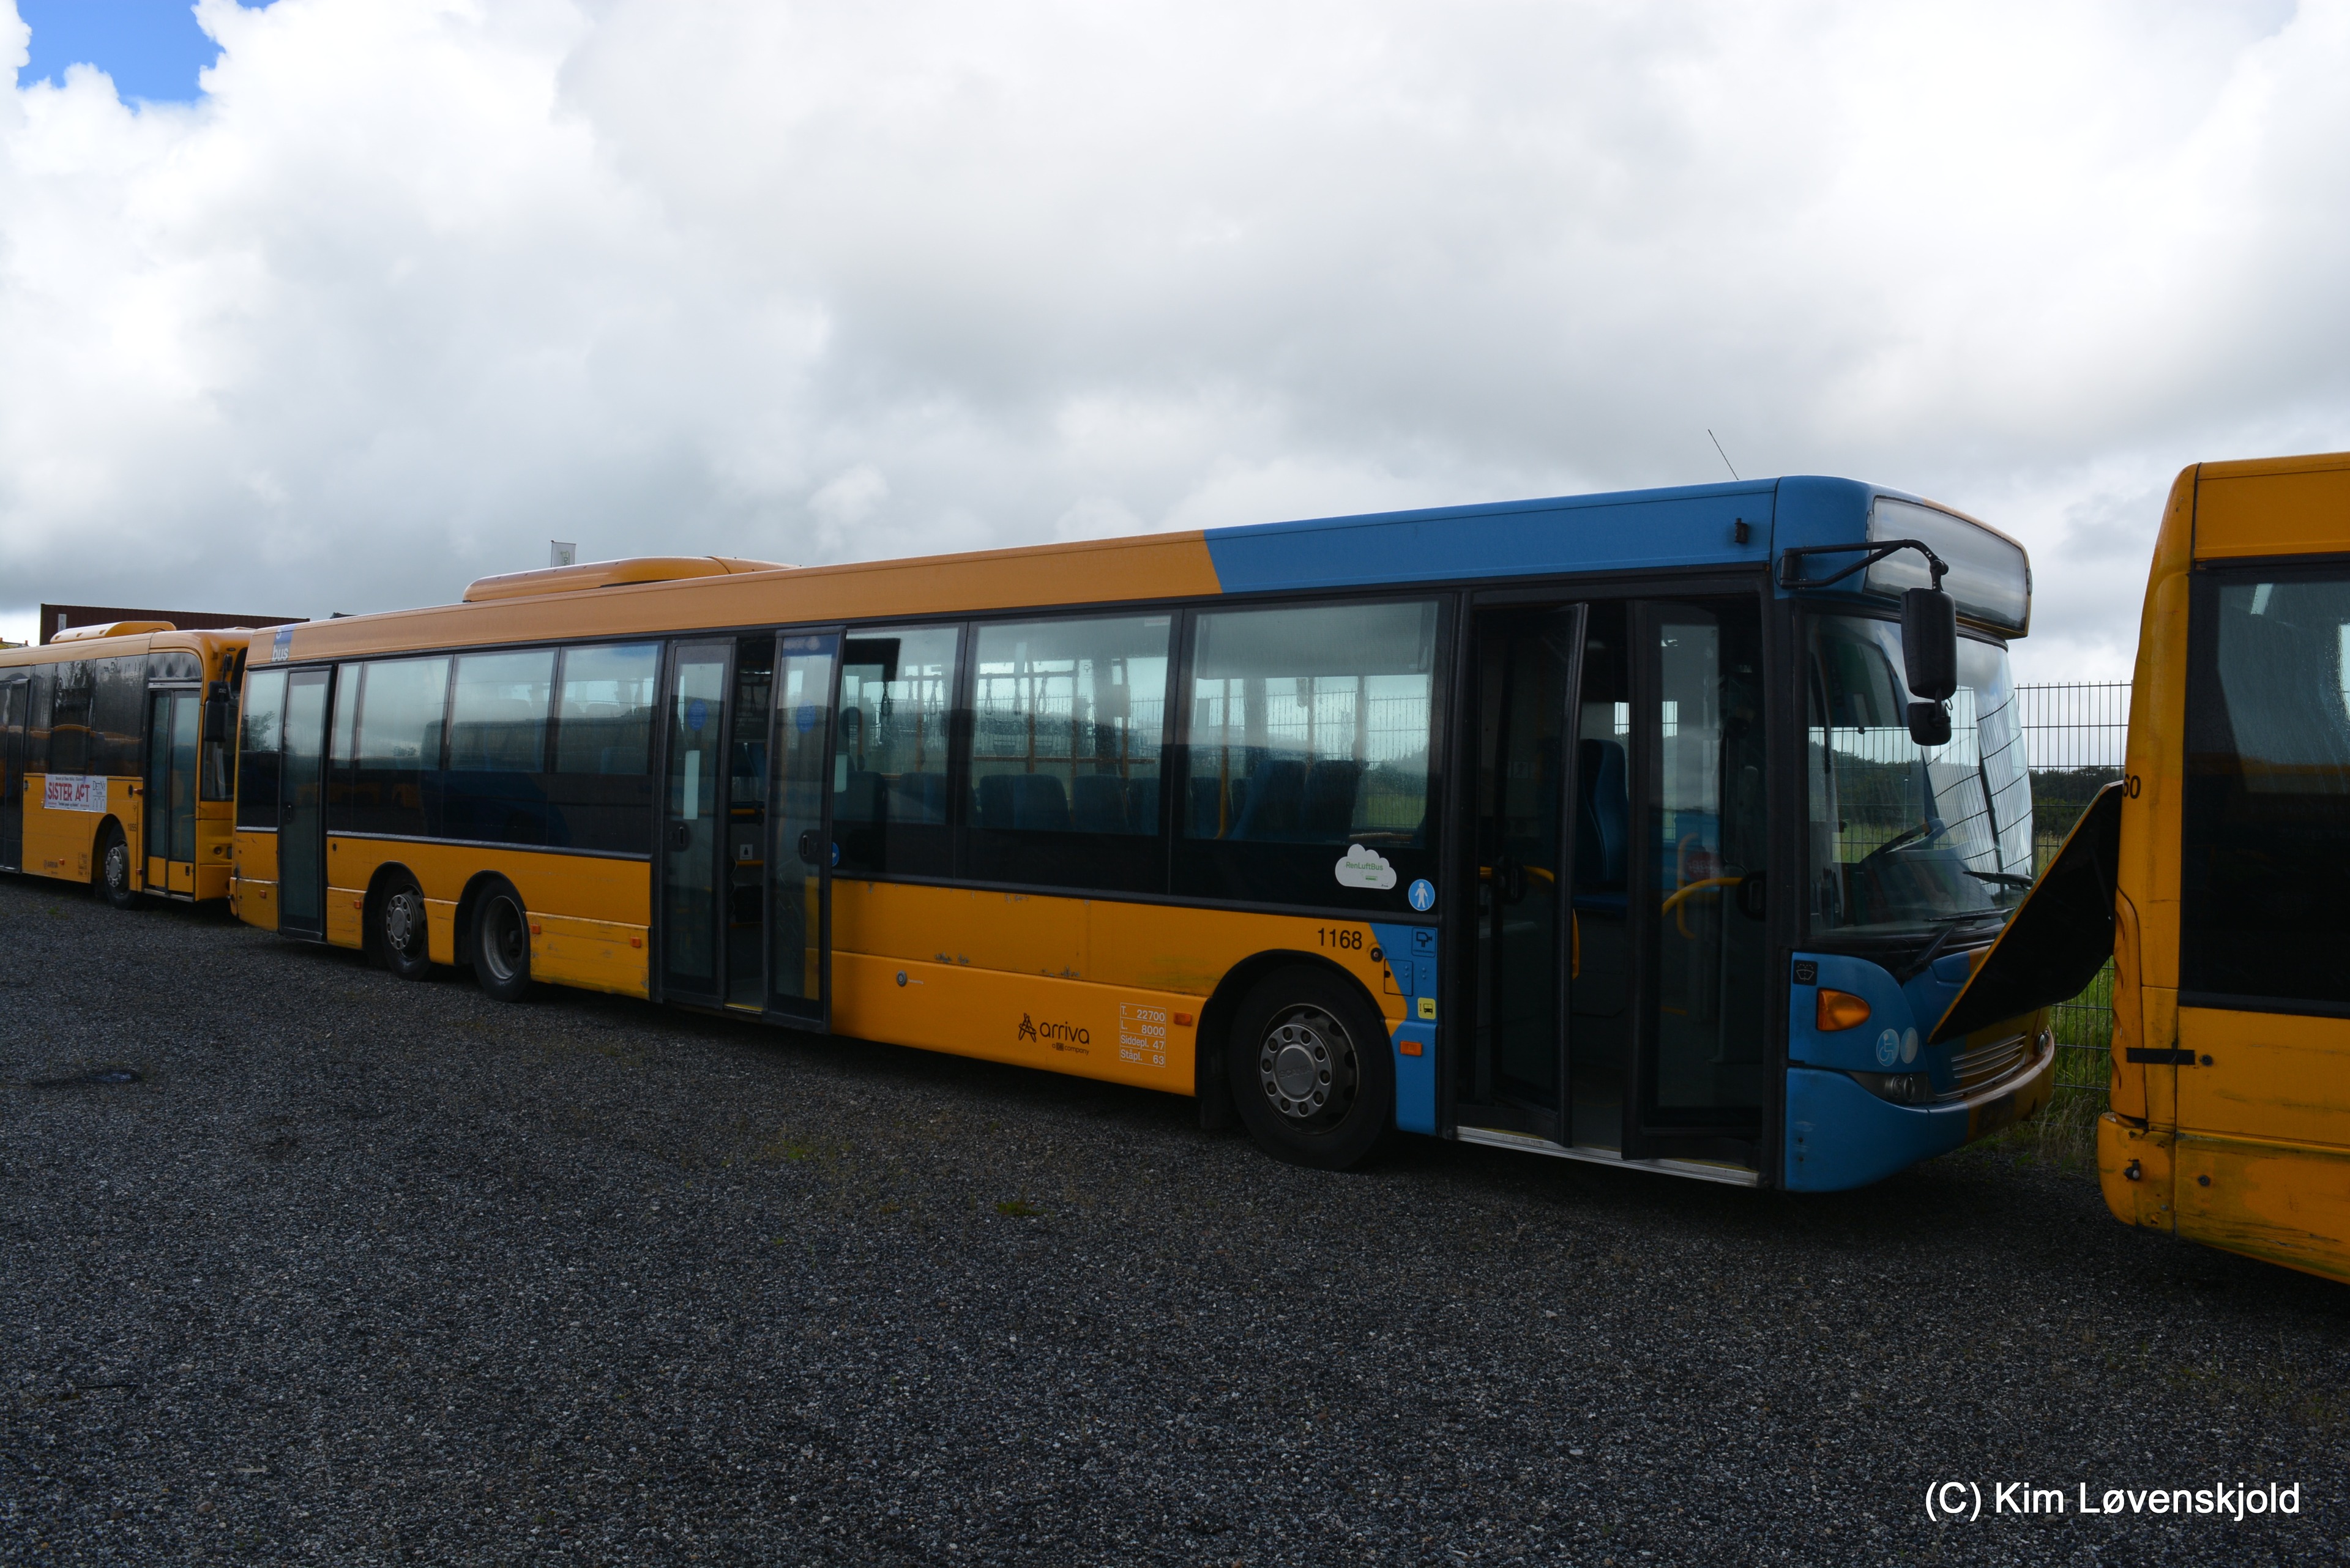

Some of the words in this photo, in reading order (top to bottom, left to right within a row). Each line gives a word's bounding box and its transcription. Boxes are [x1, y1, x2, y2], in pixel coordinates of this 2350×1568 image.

[272, 644, 289, 662] bus
[48, 782, 72, 801] SISTER
[75, 784, 90, 802] ACT
[1346, 861, 1383, 871] RenLuftBus
[1318, 927, 1362, 950] 1168
[1121, 1006, 1127, 1015] T.
[1136, 1009, 1165, 1021] 22700
[1040, 1021, 1090, 1045] arriva
[1121, 1021, 1127, 1030] L.
[1141, 1025, 1165, 1036] 8000
[1121, 1035, 1149, 1048] Siddepl.
[1152, 1040, 1165, 1050] 47
[1065, 1046, 1089, 1056] company
[1121, 1049, 1143, 1062] Ståpl.
[1153, 1055, 1165, 1065] 63
